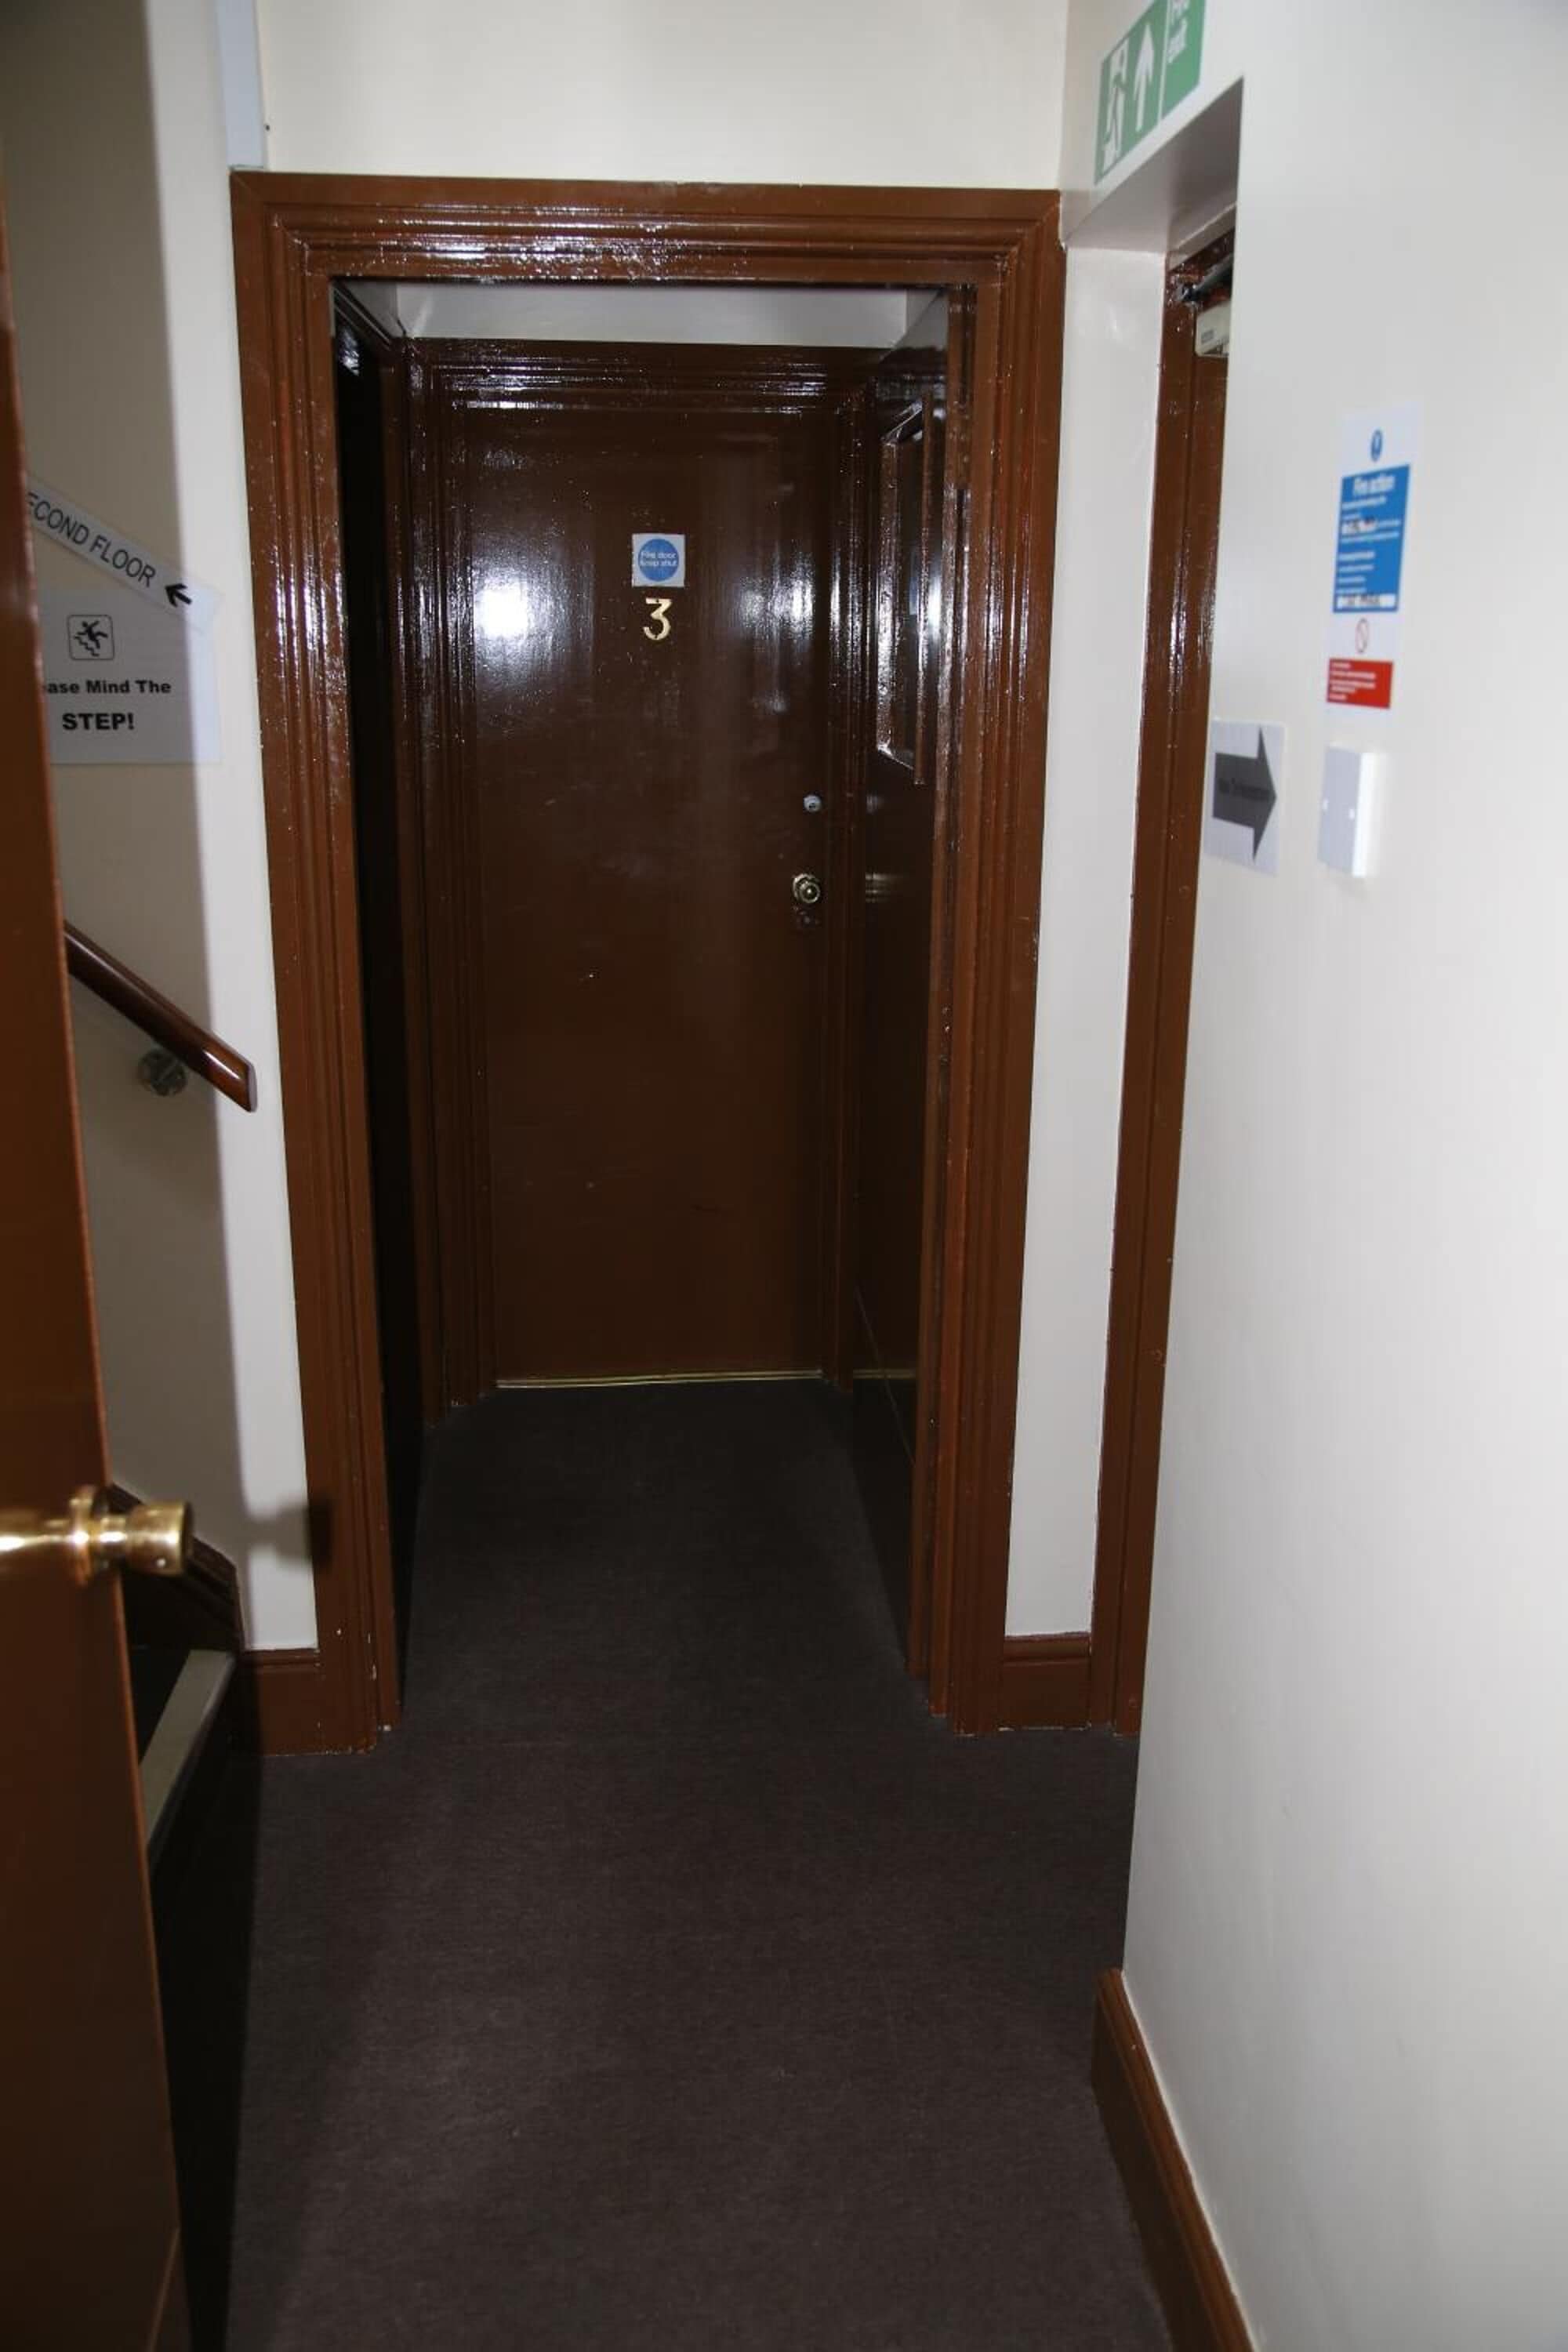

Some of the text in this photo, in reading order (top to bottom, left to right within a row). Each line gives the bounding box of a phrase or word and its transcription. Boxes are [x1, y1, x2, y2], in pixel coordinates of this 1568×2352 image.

[89, 535, 157, 587] FLOOR
[643, 597, 672, 641] 3
[85, 679, 130, 695] Mind
[135, 679, 172, 695] The
[62, 712, 135, 731] STEP!
